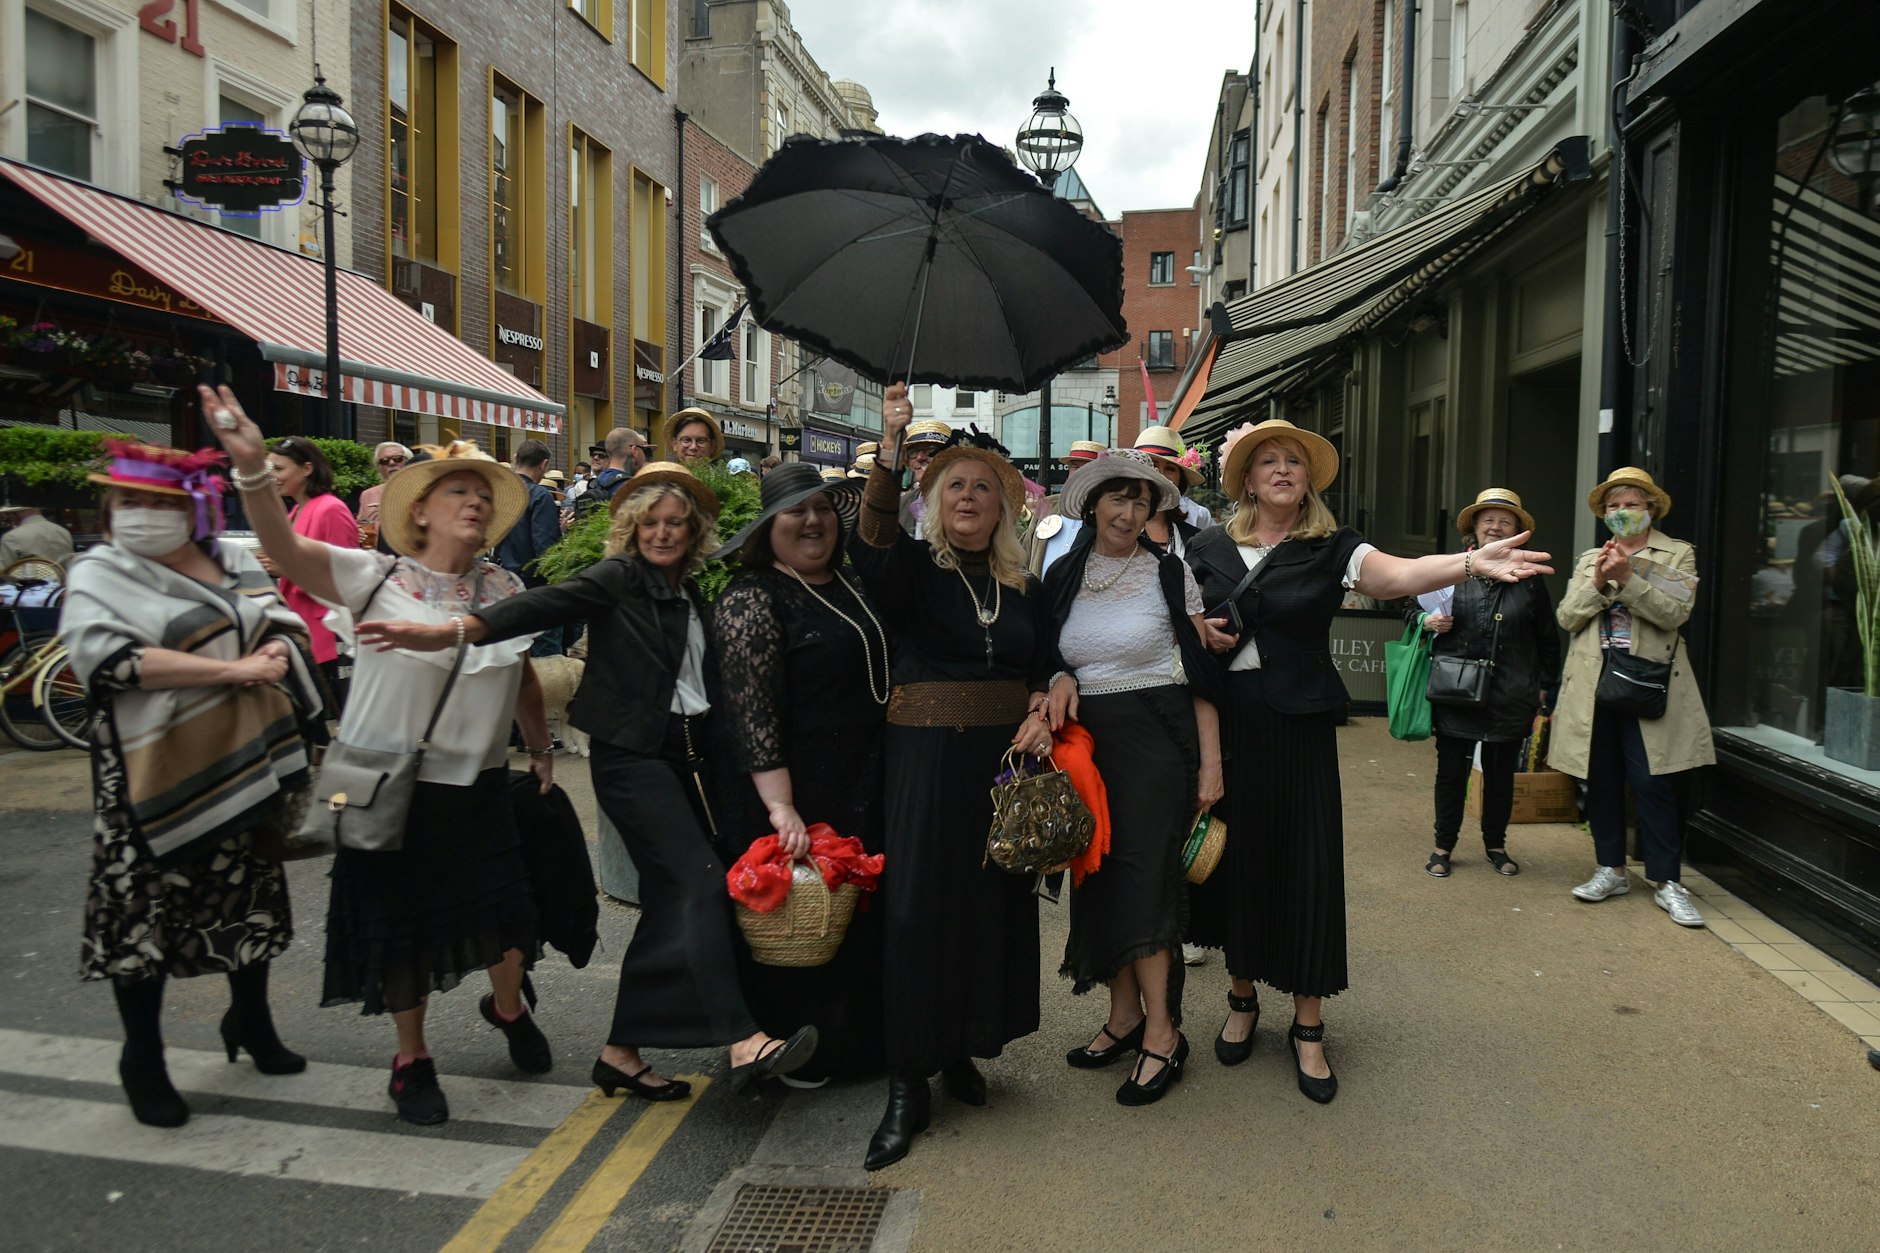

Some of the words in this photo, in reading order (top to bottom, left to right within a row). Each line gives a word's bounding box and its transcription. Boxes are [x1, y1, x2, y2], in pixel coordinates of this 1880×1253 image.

[138, 0, 206, 58] 21
[10, 250, 34, 273] 21
[109, 270, 172, 311] Davy
[497, 323, 544, 351] NESPRESSO
[635, 363, 664, 384] NESPRESSO
[816, 438, 842, 455] HICKEY'S
[1024, 463, 1056, 471] PAMA
[1332, 639, 1376, 656] ILEY
